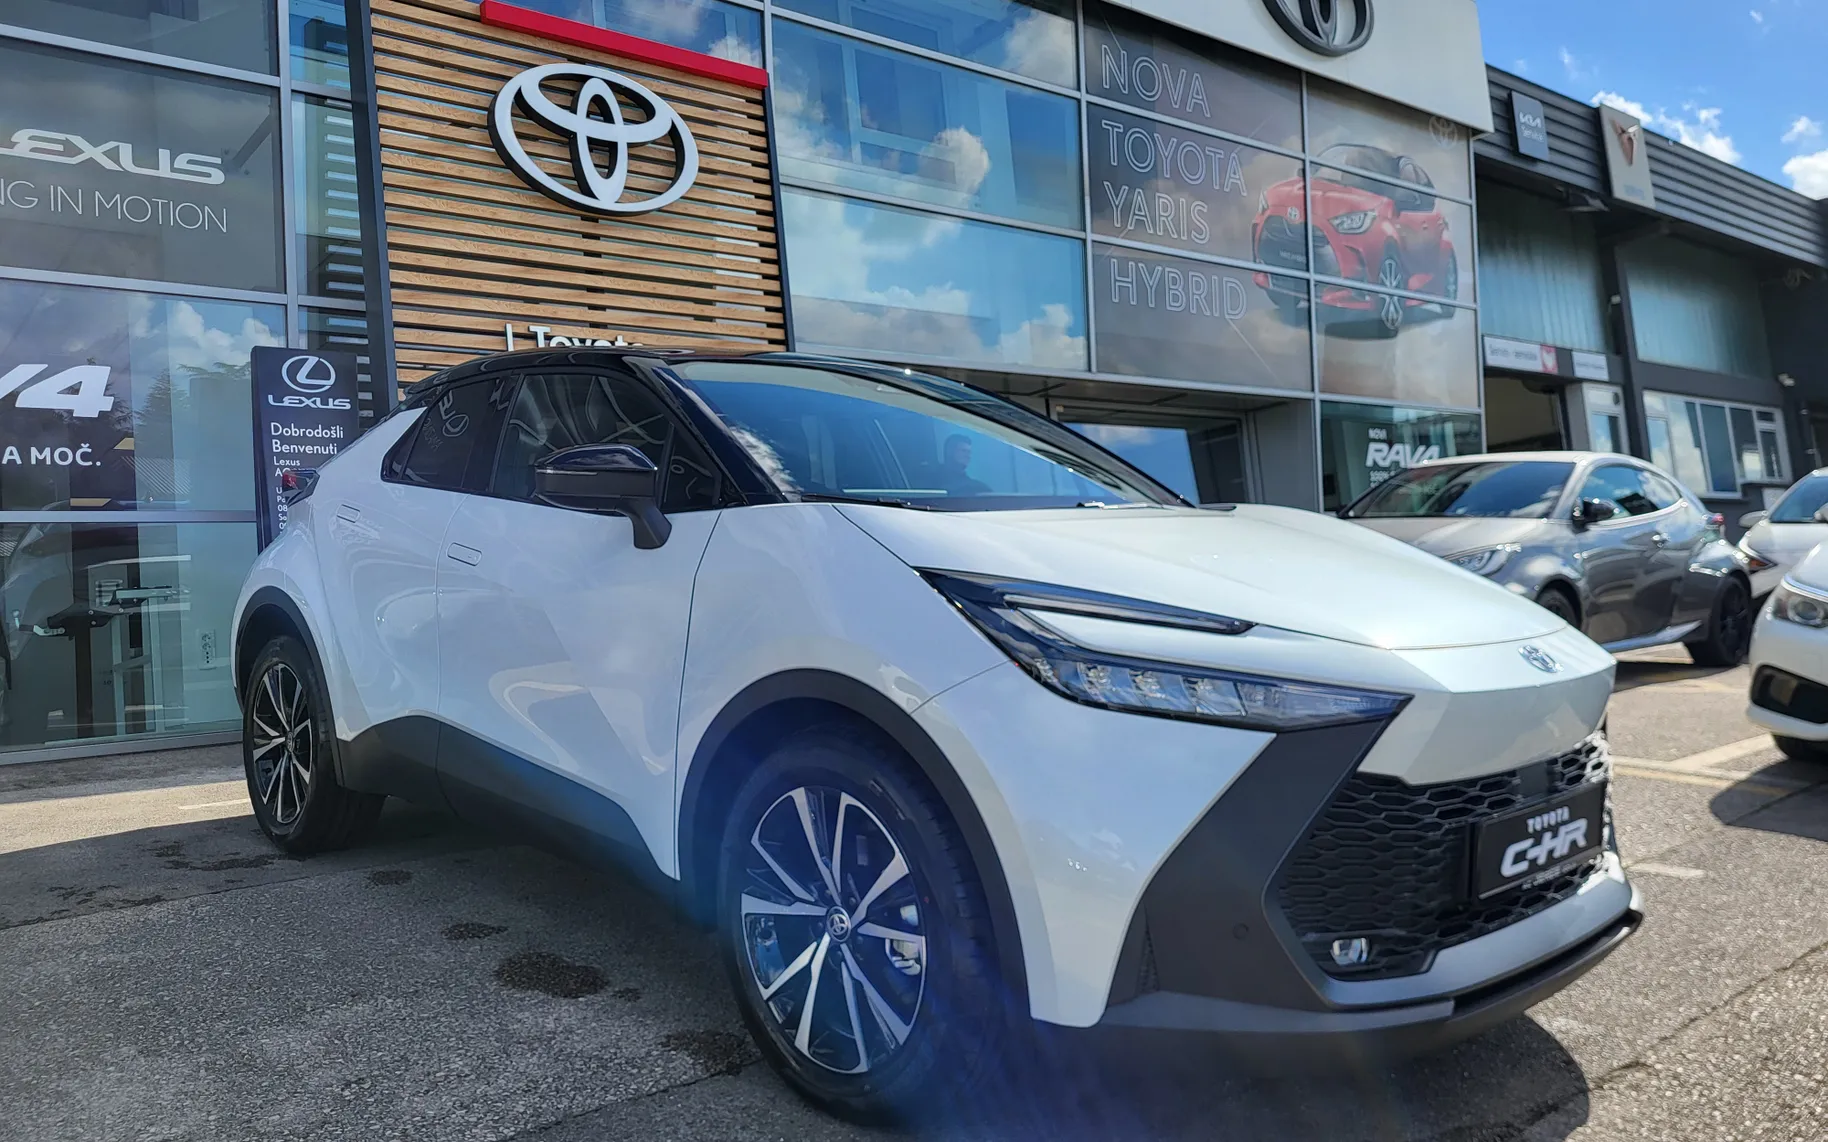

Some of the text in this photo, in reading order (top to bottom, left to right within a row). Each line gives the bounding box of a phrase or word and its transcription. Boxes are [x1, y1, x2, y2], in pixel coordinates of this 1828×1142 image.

[1101, 44, 1211, 118] NOVA
[0, 128, 225, 185] EXUS
[1101, 119, 1248, 196] TOYOTA
[0, 178, 228, 233] G IN MOTION
[1103, 181, 1210, 244] YARIS
[1110, 258, 1248, 320] HYBRID
[267, 394, 352, 410] LEXUS
[270, 422, 344, 439] Dobrodošli
[271, 439, 338, 455] Benvenuti
[30, 443, 102, 466] MOČ.
[273, 456, 301, 466] Lexus
[1526, 806, 1570, 834] TOYOTA
